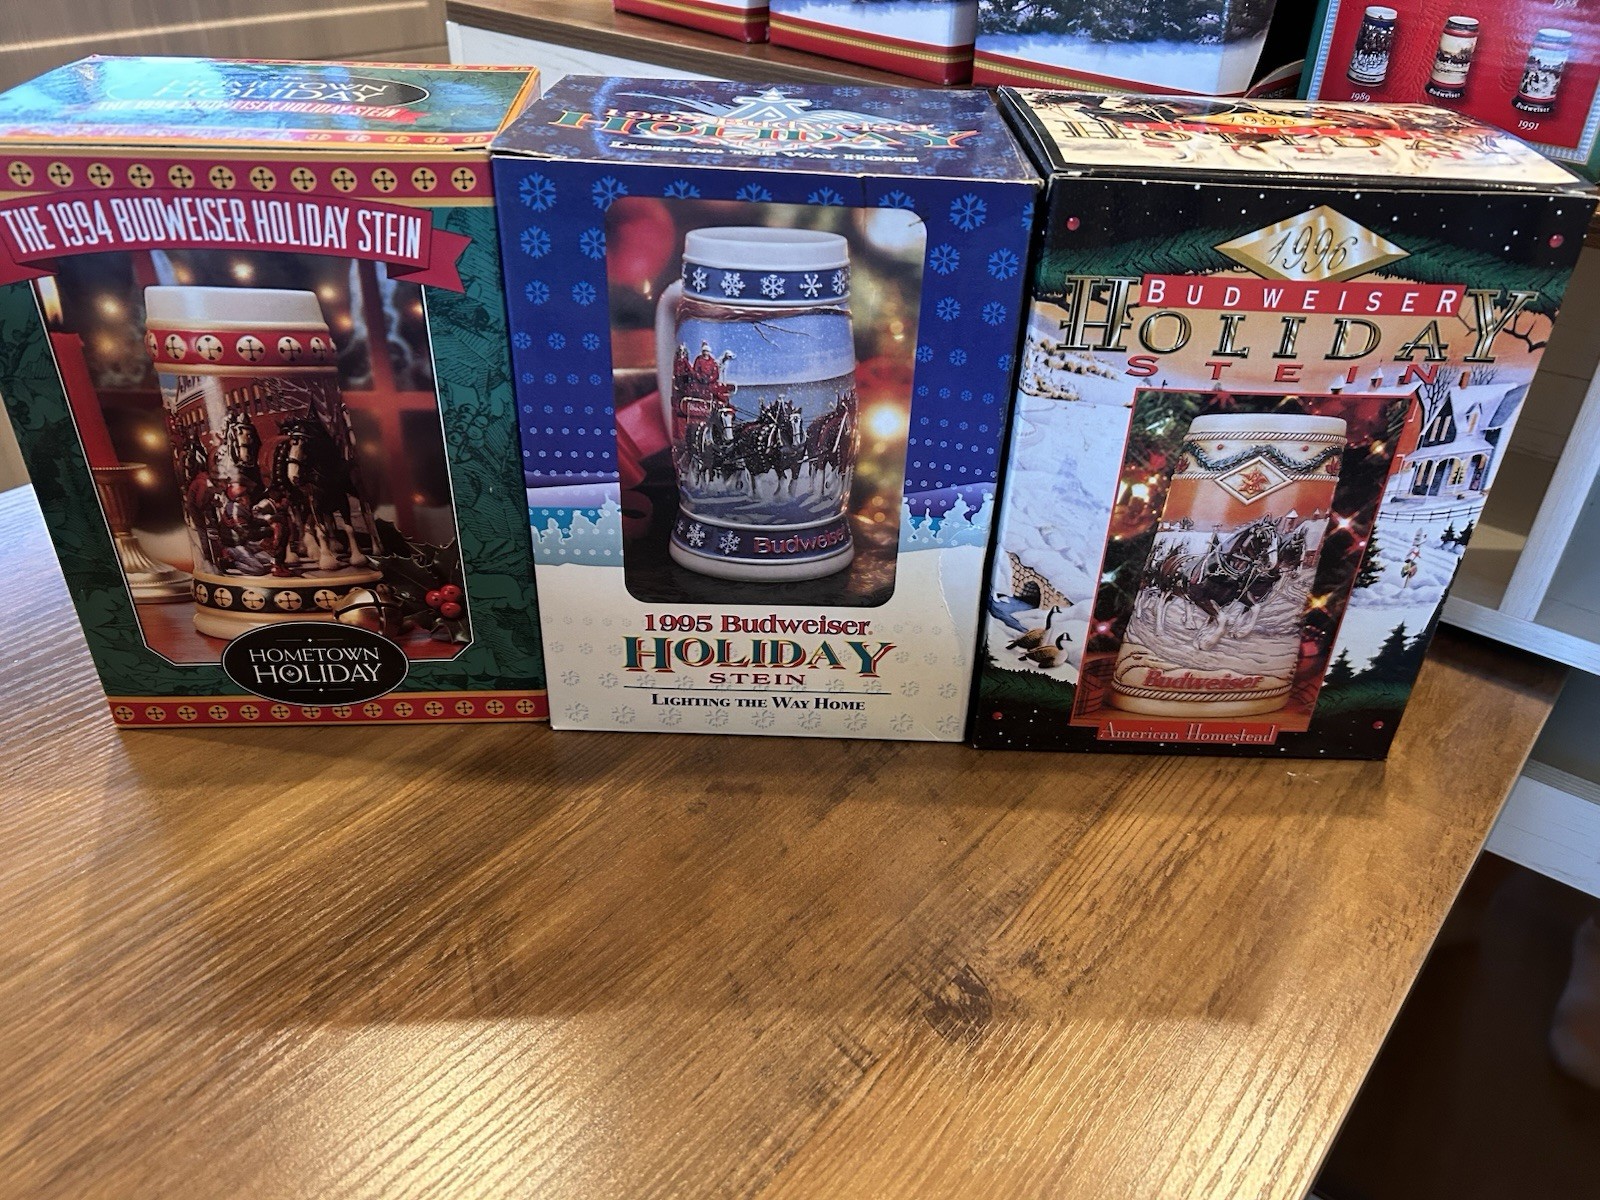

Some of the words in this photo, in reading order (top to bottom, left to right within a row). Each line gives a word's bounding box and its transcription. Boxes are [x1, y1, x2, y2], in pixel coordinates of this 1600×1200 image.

[1351, 92, 1371, 103] 1989
[1515, 101, 1551, 113] Budweiser
[278, 102, 350, 115] HOLIDAY
[350, 106, 400, 119] STEIN
[1225, 115, 1297, 126] 1996
[547, 109, 981, 149] HOLIDAY
[1518, 120, 1540, 131] 1991
[782, 151, 838, 160] WAY
[842, 154, 920, 164] HOME
[0, 205, 56, 254] THE
[46, 200, 114, 248] 1994
[109, 197, 251, 243] BUDWEISER
[251, 199, 350, 250] HOLIDAY
[356, 208, 422, 260] STEIN
[1268, 225, 1358, 274] 1996
[1146, 279, 1458, 314] BUDWEISER
[1056, 274, 1539, 364] HOLIDAY
[1125, 354, 1440, 385] STEIN
[753, 526, 846, 554] Budweise
[645, 614, 713, 633] 1995
[720, 614, 871, 636] Budweiser
[249, 647, 380, 662] HOMETOWN
[622, 635, 897, 678] HOLIDAY
[252, 663, 383, 684] HOLIDAY
[708, 672, 806, 686] STEIN
[1142, 668, 1264, 691] Budweiser
[651, 693, 731, 708] LIGHTING
[735, 698, 767, 709] THE
[771, 696, 810, 709] WAY
[814, 697, 866, 711] HOME
[1099, 721, 1180, 741] American
[1185, 722, 1277, 743] Homestead
